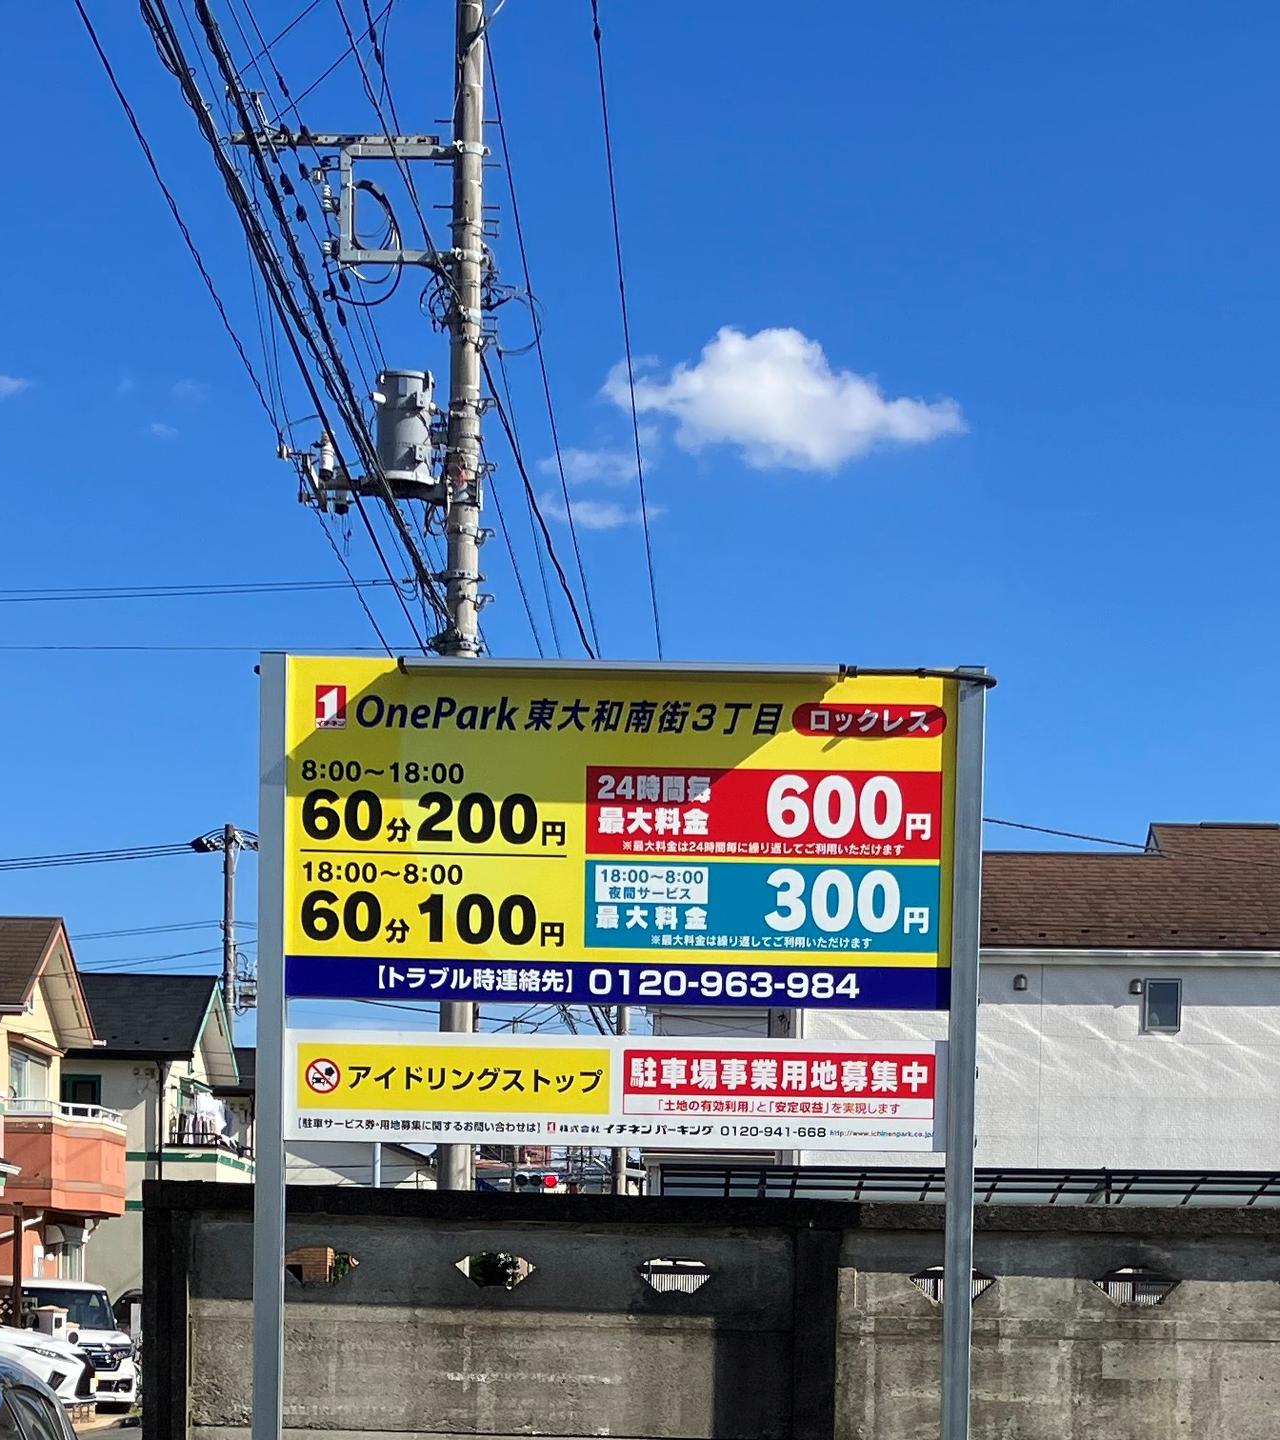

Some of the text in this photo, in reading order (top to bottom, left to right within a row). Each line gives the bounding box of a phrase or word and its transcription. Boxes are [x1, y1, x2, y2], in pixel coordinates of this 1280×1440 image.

[356, 695, 784, 735] OnePark 東大和南街3丁目
[810, 709, 930, 732] ロックレス
[597, 775, 711, 803] 24時間毎
[597, 807, 709, 835] 最大料金
[766, 774, 932, 840] 600円
[608, 886, 691, 900] 夜間サービス
[764, 868, 930, 934] 300円
[595, 905, 708, 931] 最大料金
[378, 965, 860, 999] 【トラブル時連絡先】 0120-963-984
[348, 1065, 604, 1094] アイドリングストップ
[629, 1056, 929, 1093] 駐車場事業用地募集中
[559, 1124, 600, 1134] 株式会社
[720, 1125, 827, 1138] 0120-941-668
